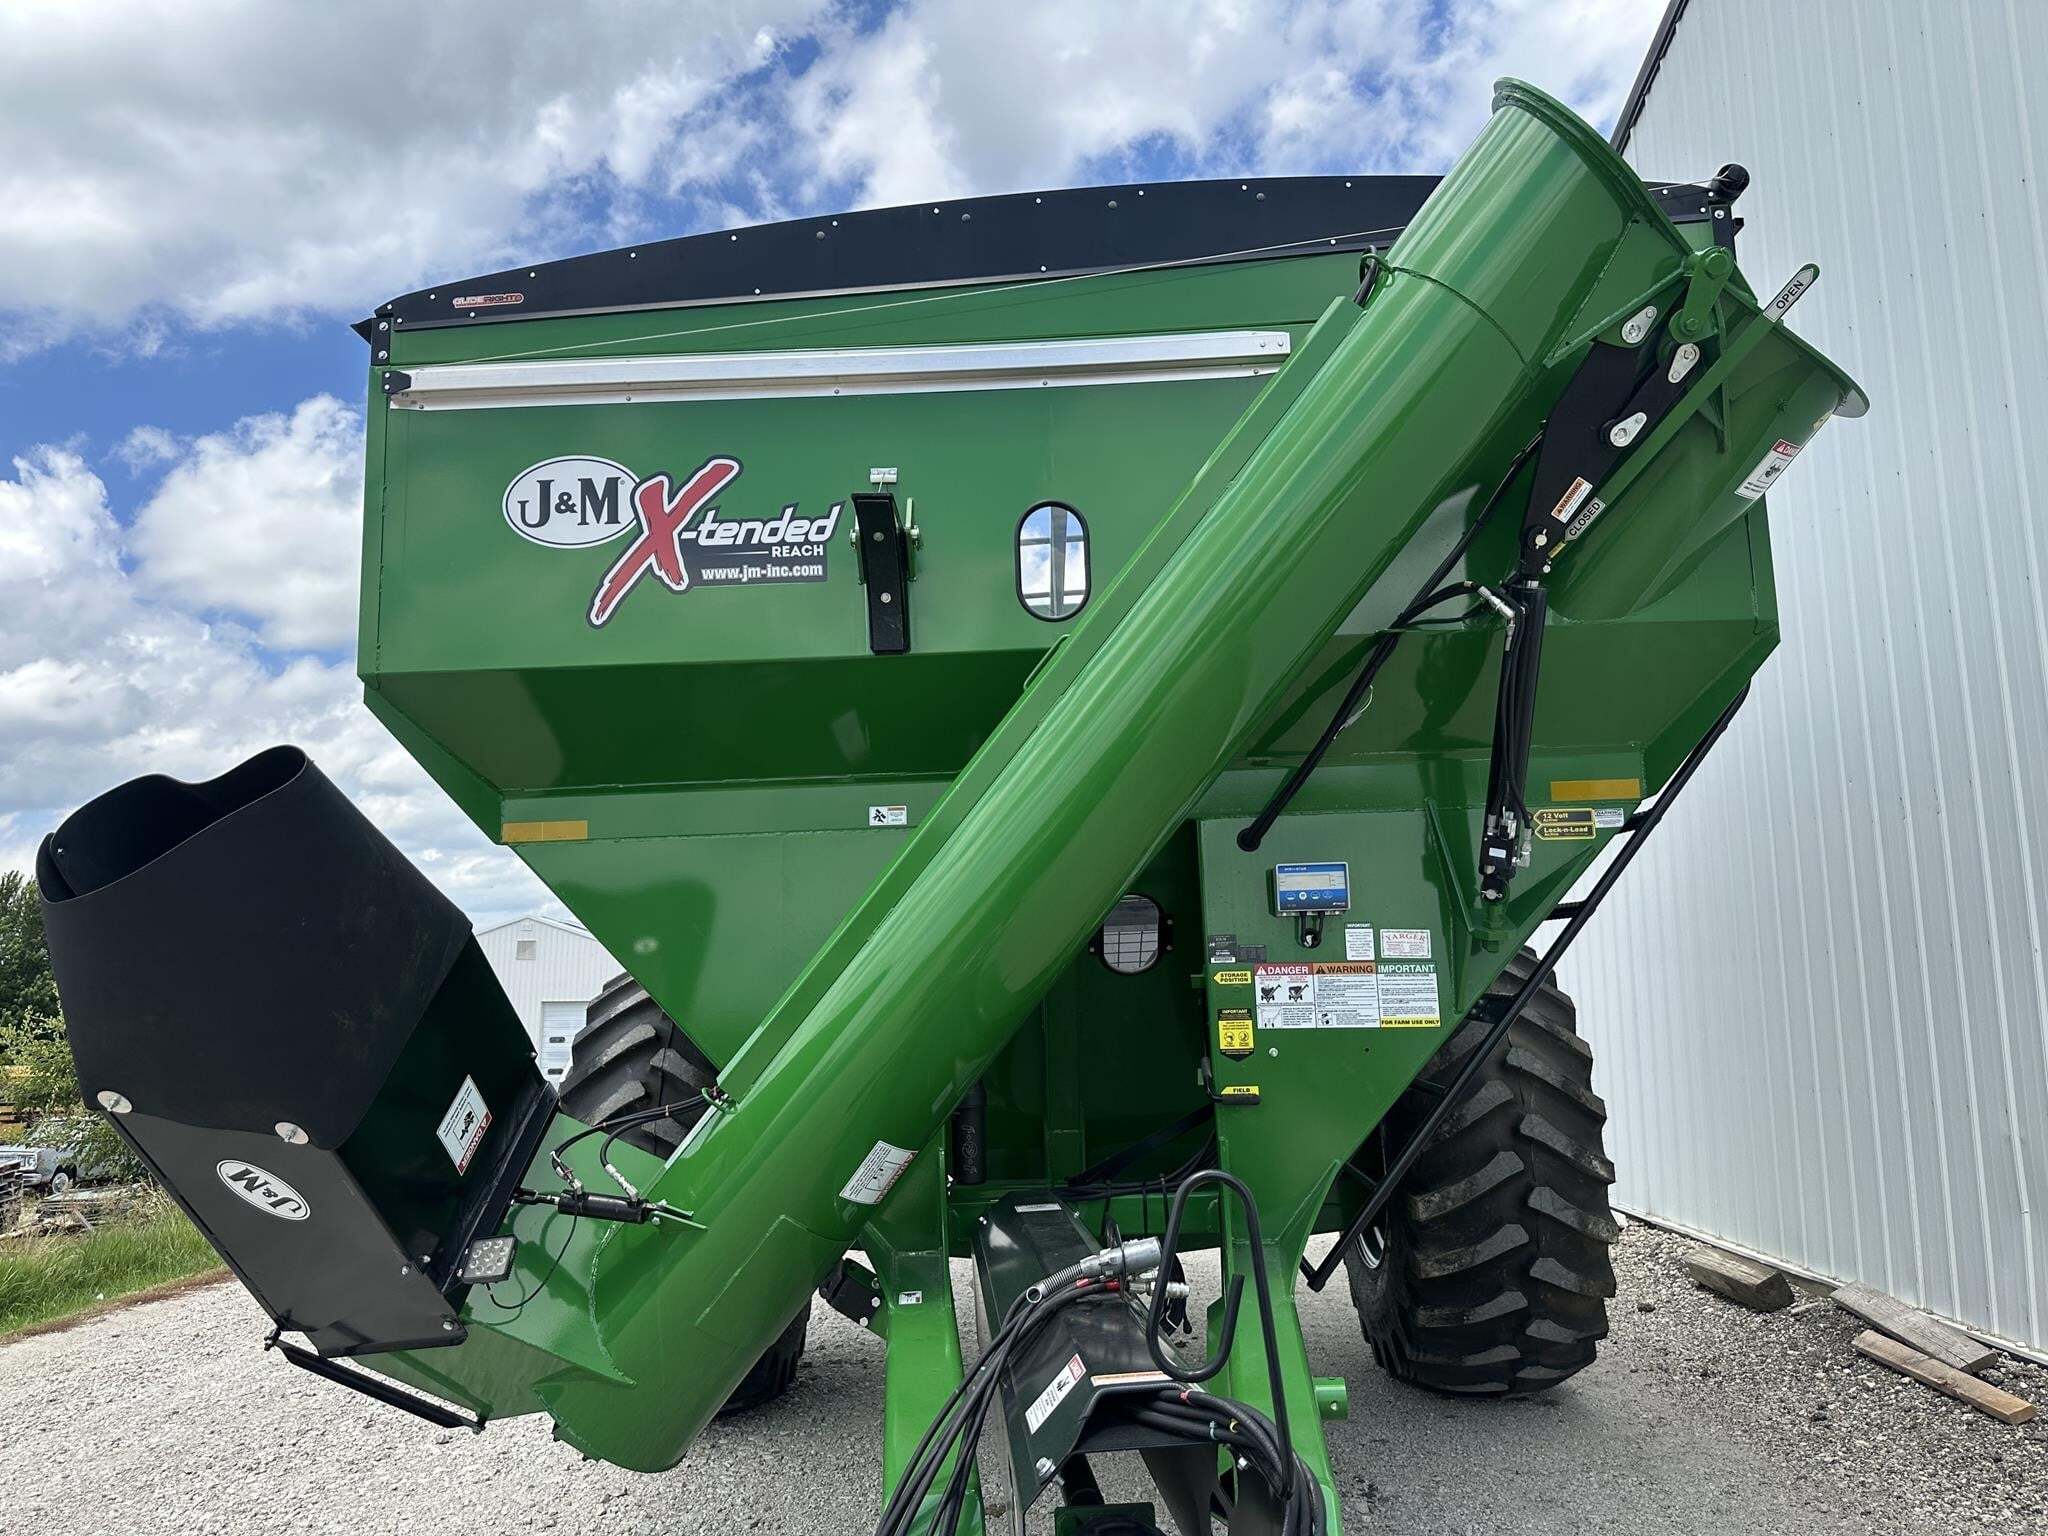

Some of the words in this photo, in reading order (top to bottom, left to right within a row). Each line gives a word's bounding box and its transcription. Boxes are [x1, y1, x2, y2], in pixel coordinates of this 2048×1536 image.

[1776, 280, 1804, 309] OPEN
[517, 476, 622, 529] J&M
[1568, 502, 1600, 537] CLOSED
[771, 544, 824, 558] REACH
[701, 563, 824, 582] www.jm-inc.com
[1267, 966, 1309, 975] DANGER
[1326, 965, 1374, 974] WARNING
[1377, 964, 1435, 973] IMPORTANT
[226, 1168, 302, 1214] J&M
